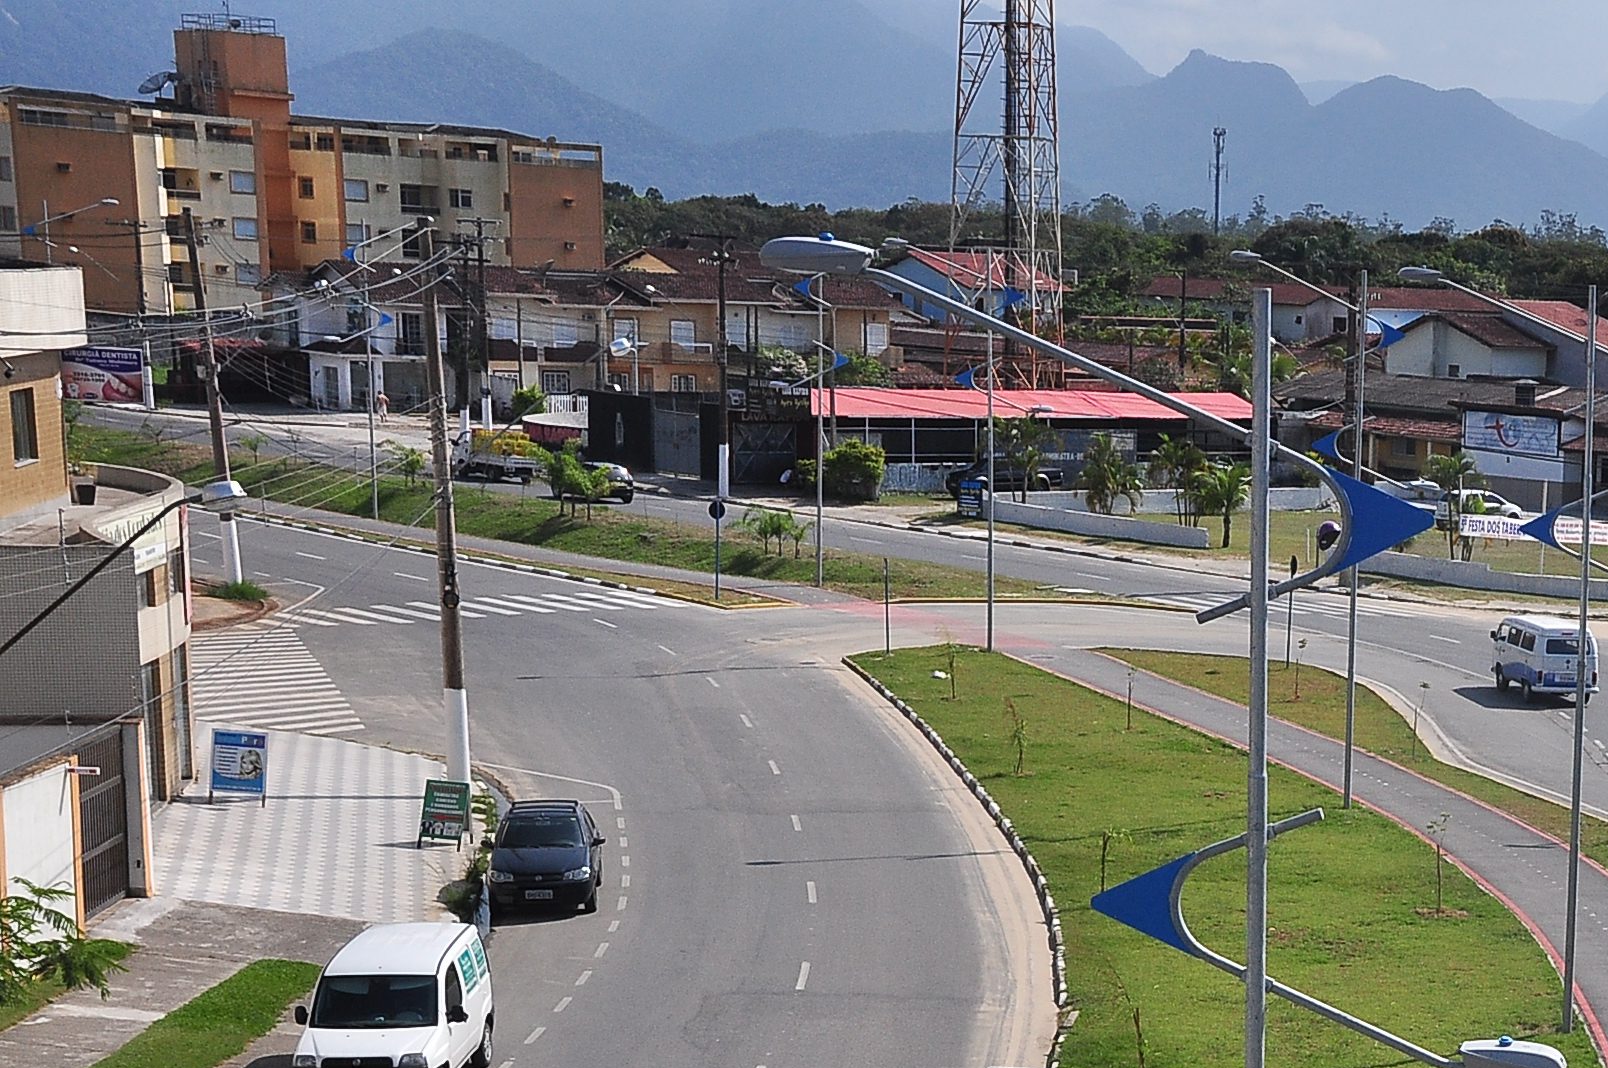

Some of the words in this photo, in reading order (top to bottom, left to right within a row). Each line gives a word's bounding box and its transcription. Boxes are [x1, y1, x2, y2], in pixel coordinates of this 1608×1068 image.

[101, 351, 138, 360] DENTISTA
[1468, 519, 1486, 533] FESTA
[1487, 520, 1501, 534] DOS
